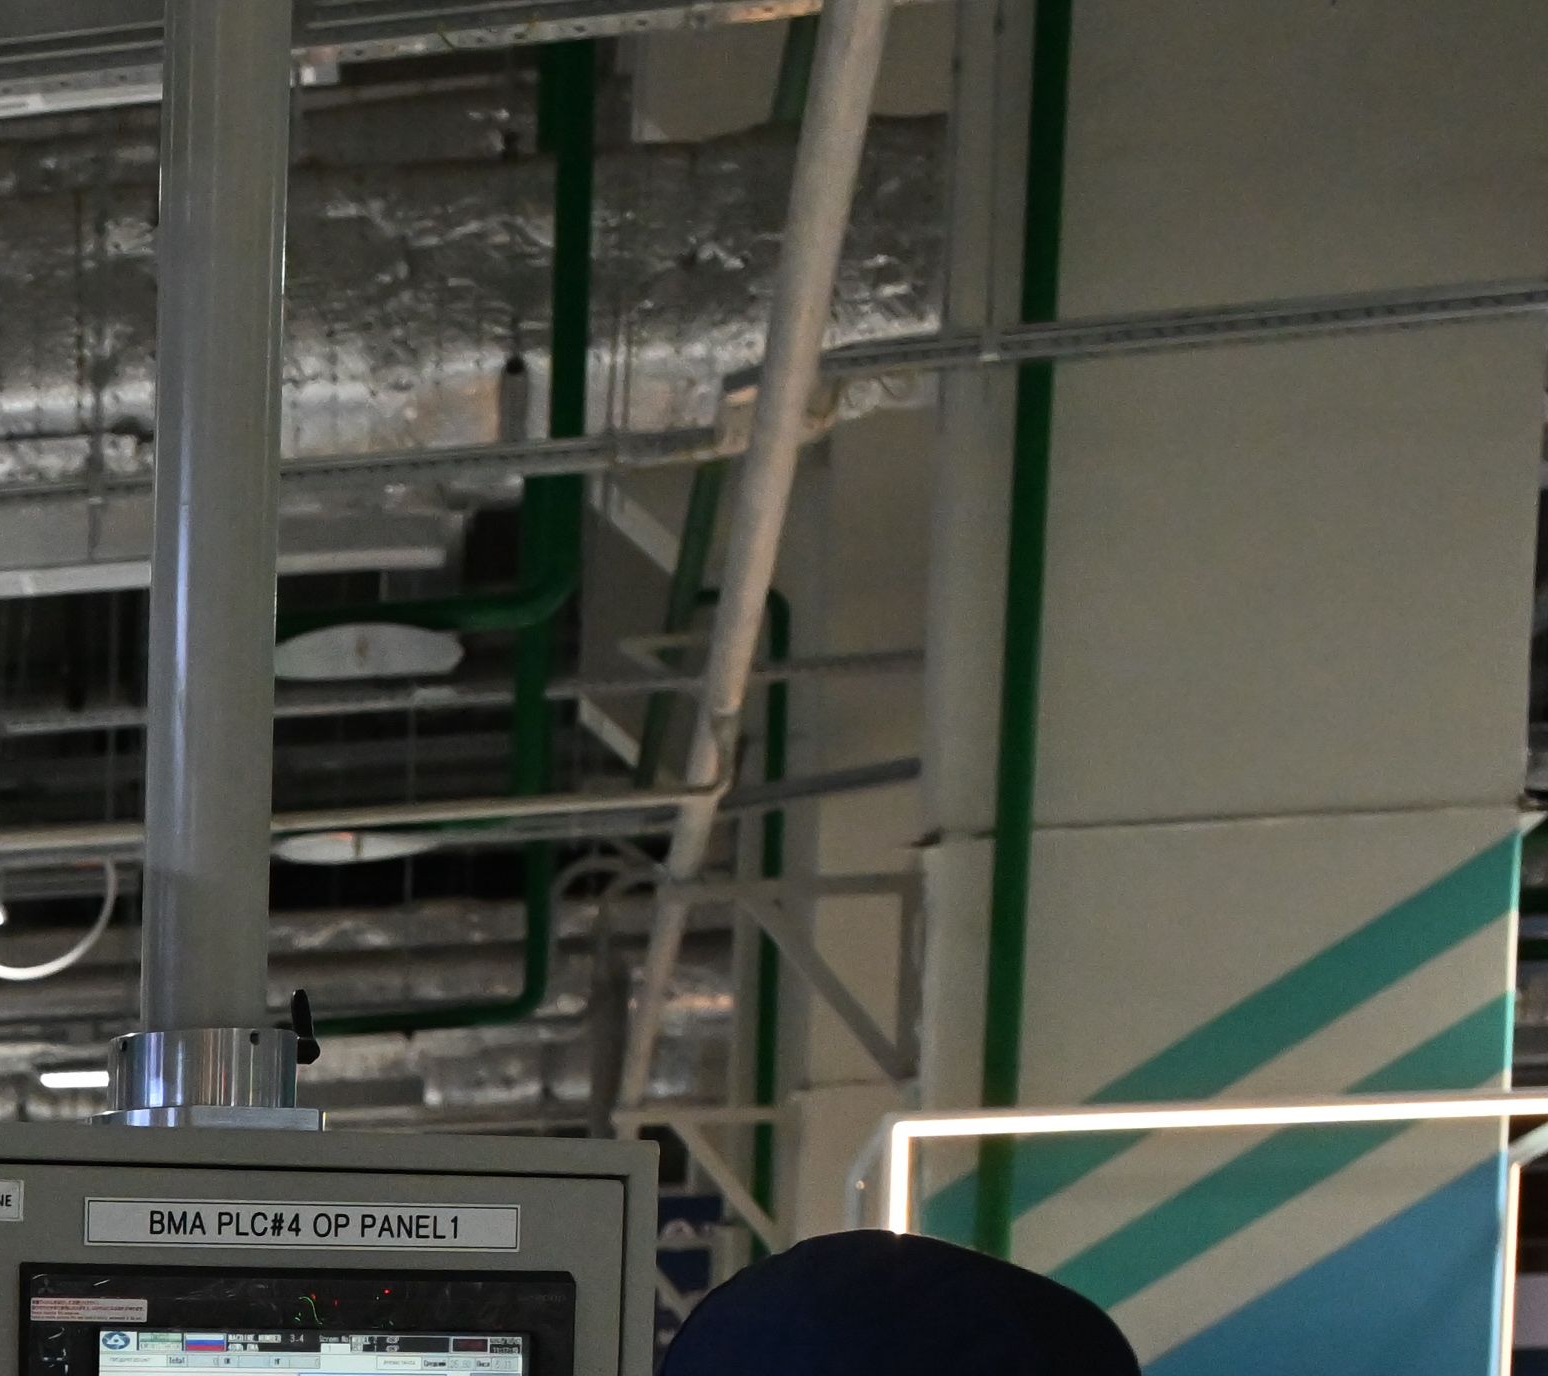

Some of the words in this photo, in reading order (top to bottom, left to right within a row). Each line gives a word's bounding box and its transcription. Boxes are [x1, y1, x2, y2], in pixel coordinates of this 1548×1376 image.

[148, 1210, 206, 1236] BMA
[216, 1211, 302, 1238] PLC#4
[312, 1212, 351, 1239] OP
[360, 1213, 459, 1240] PANEL1
